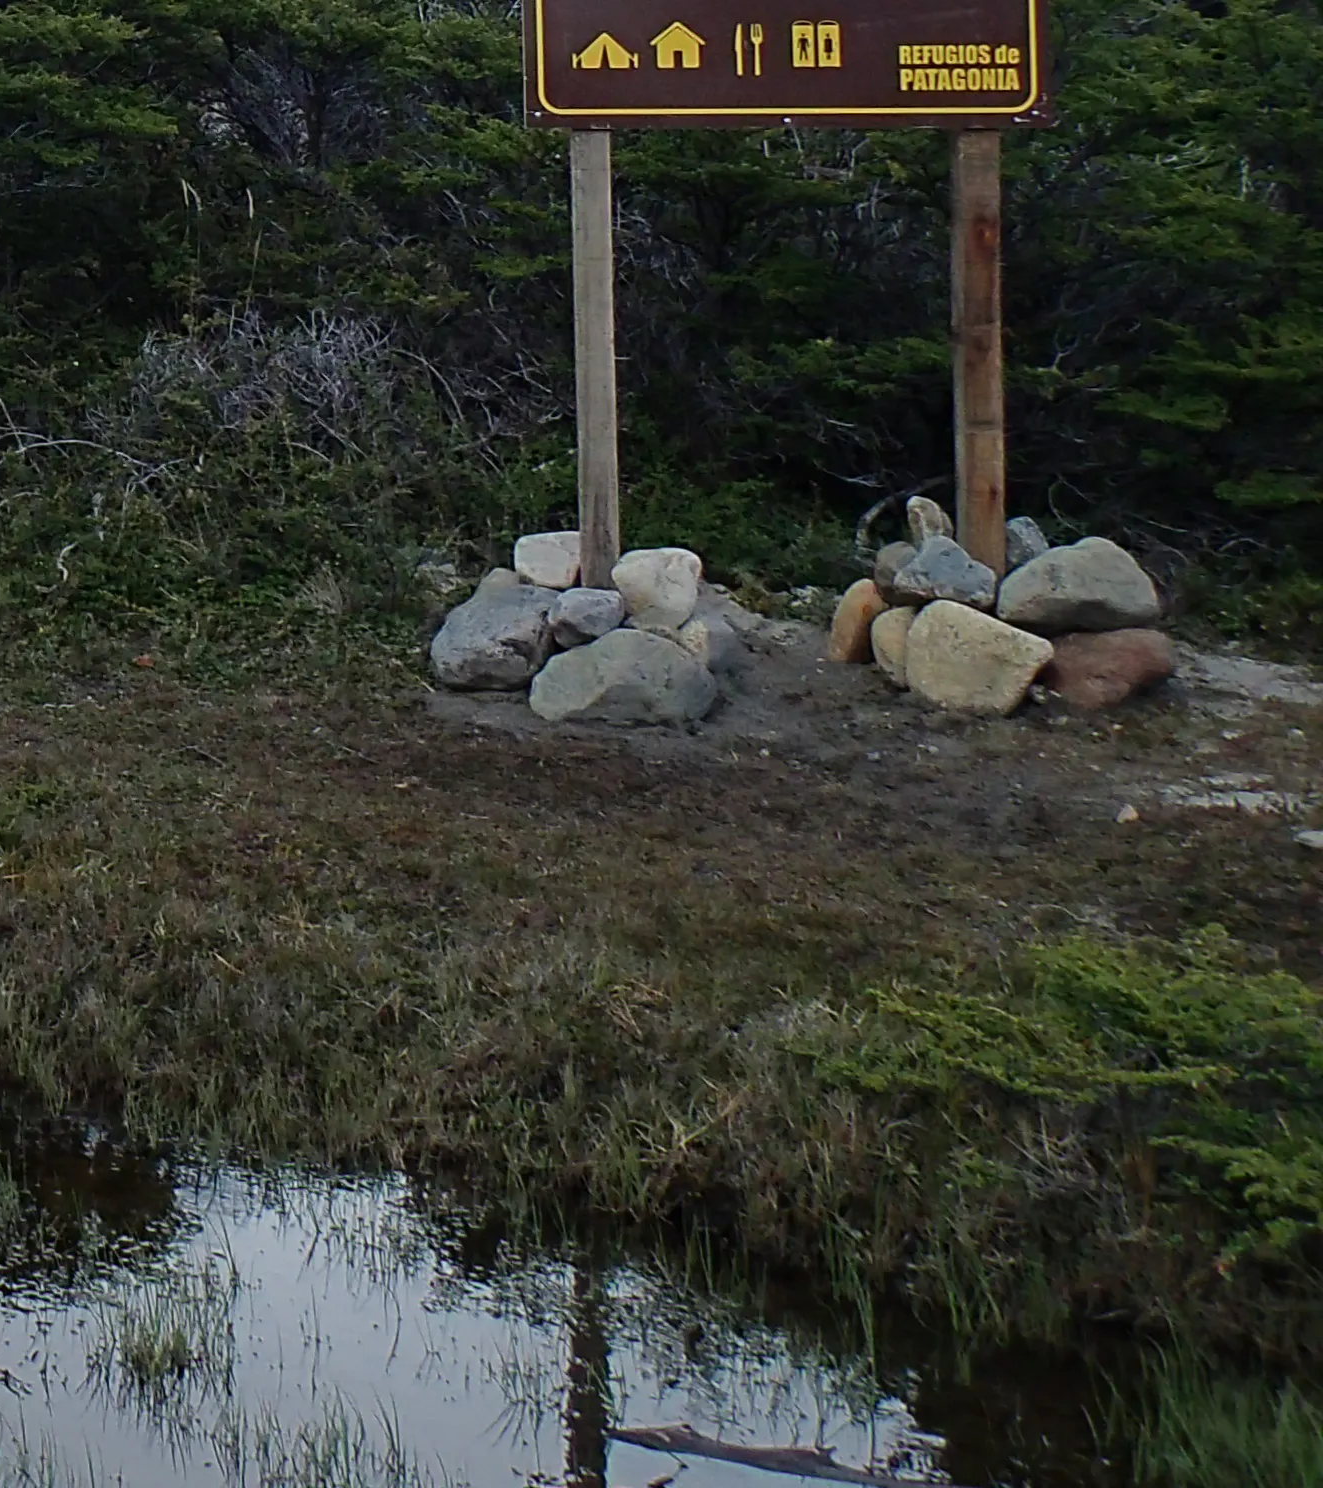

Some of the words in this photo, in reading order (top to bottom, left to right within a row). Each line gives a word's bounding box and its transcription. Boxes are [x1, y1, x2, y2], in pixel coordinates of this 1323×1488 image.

[898, 44, 991, 65] REFUGIOS
[994, 44, 1020, 64] de
[899, 68, 1020, 91] PATAGONIA
